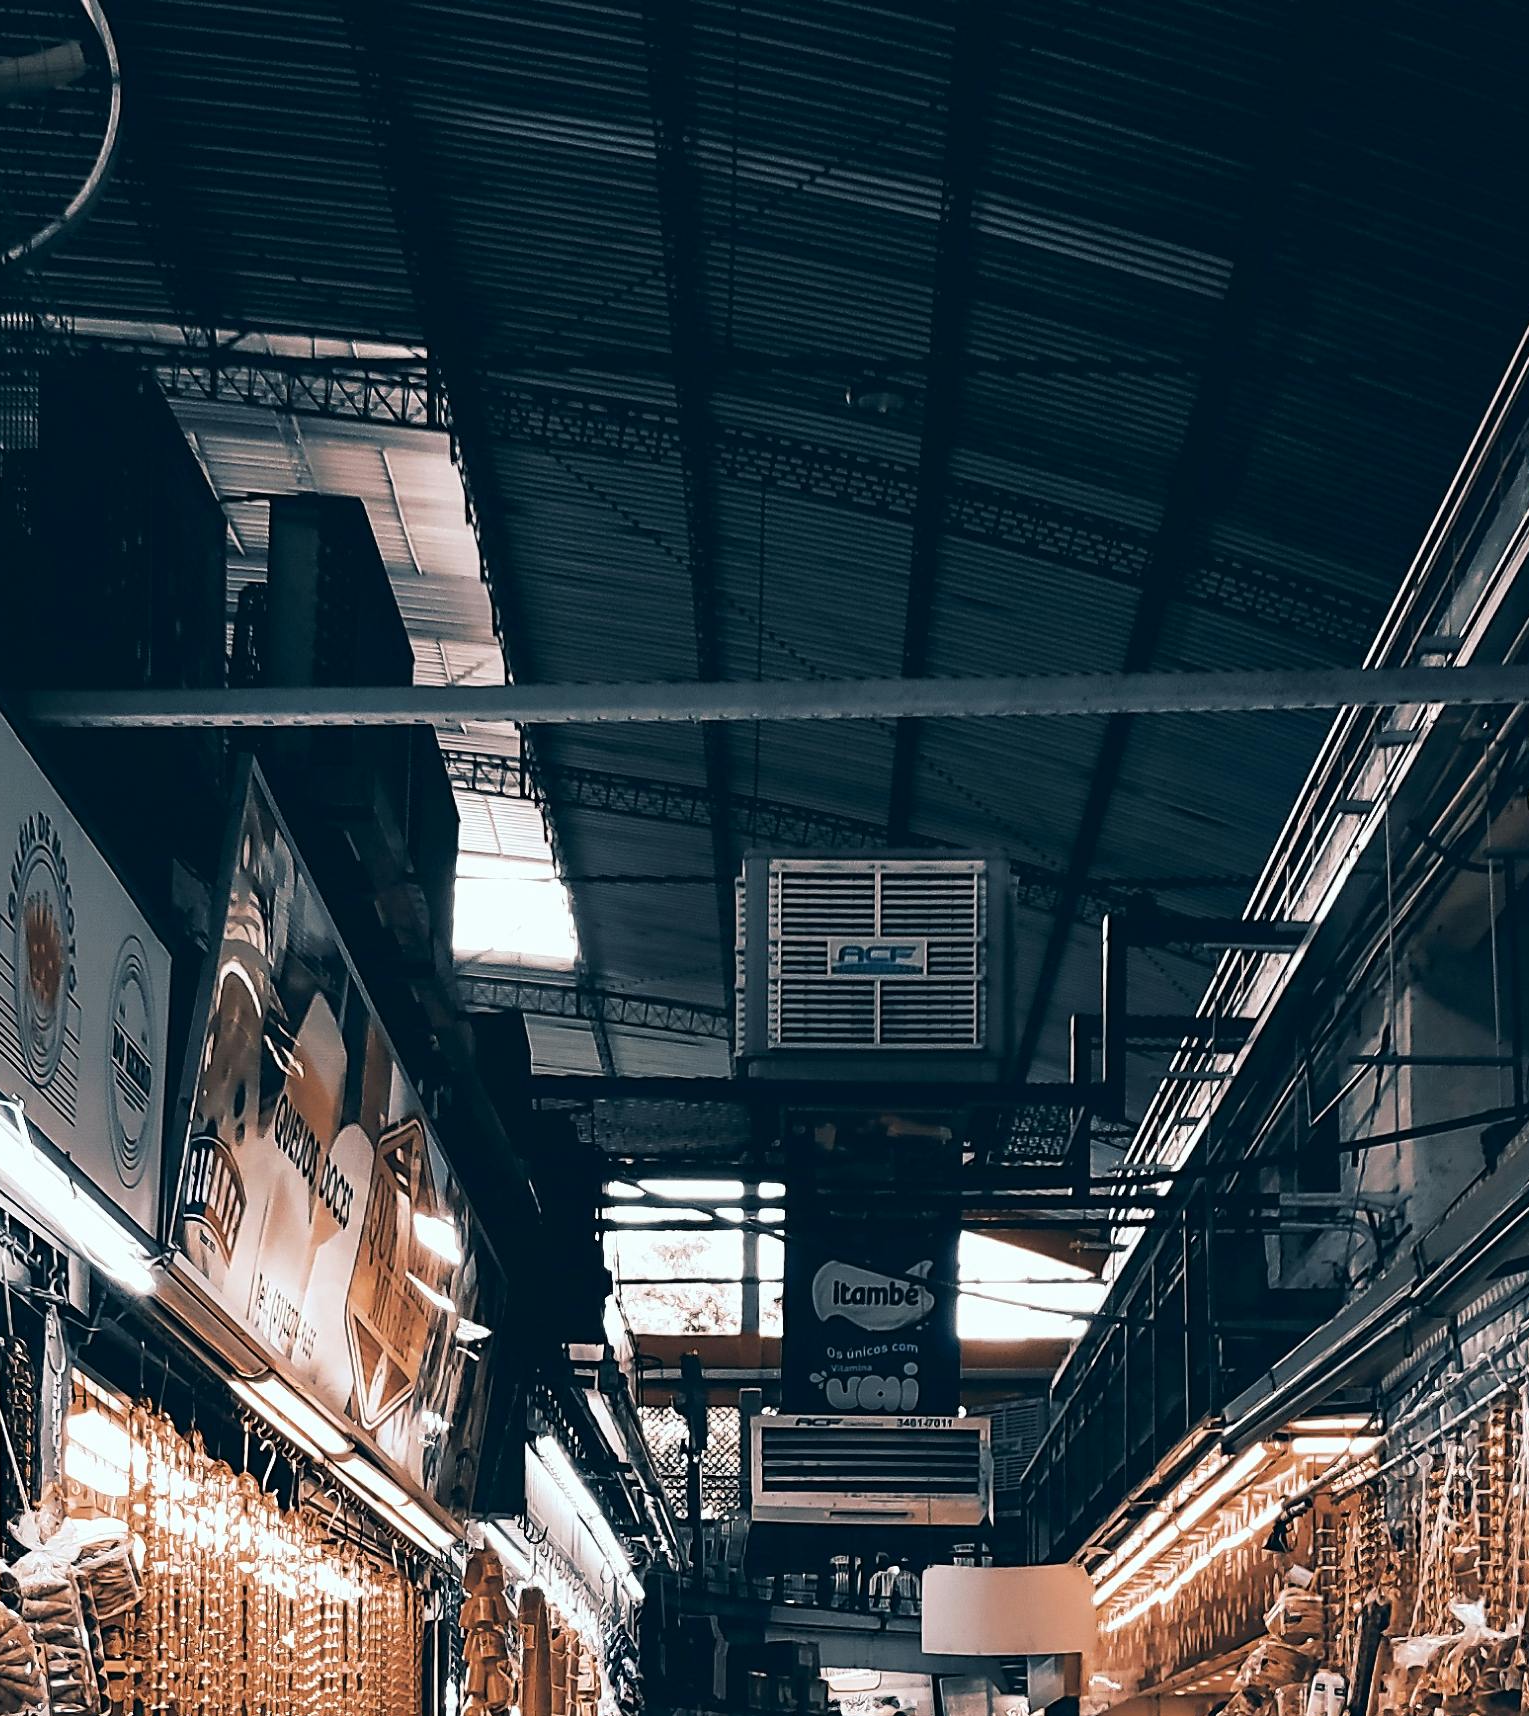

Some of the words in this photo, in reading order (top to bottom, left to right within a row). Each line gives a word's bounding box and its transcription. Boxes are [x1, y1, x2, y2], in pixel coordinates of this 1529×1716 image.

[319, 1153, 354, 1230] DOCES
[827, 1347, 842, 1361] Os
[847, 1344, 888, 1359] únicos
[892, 1343, 919, 1353] com
